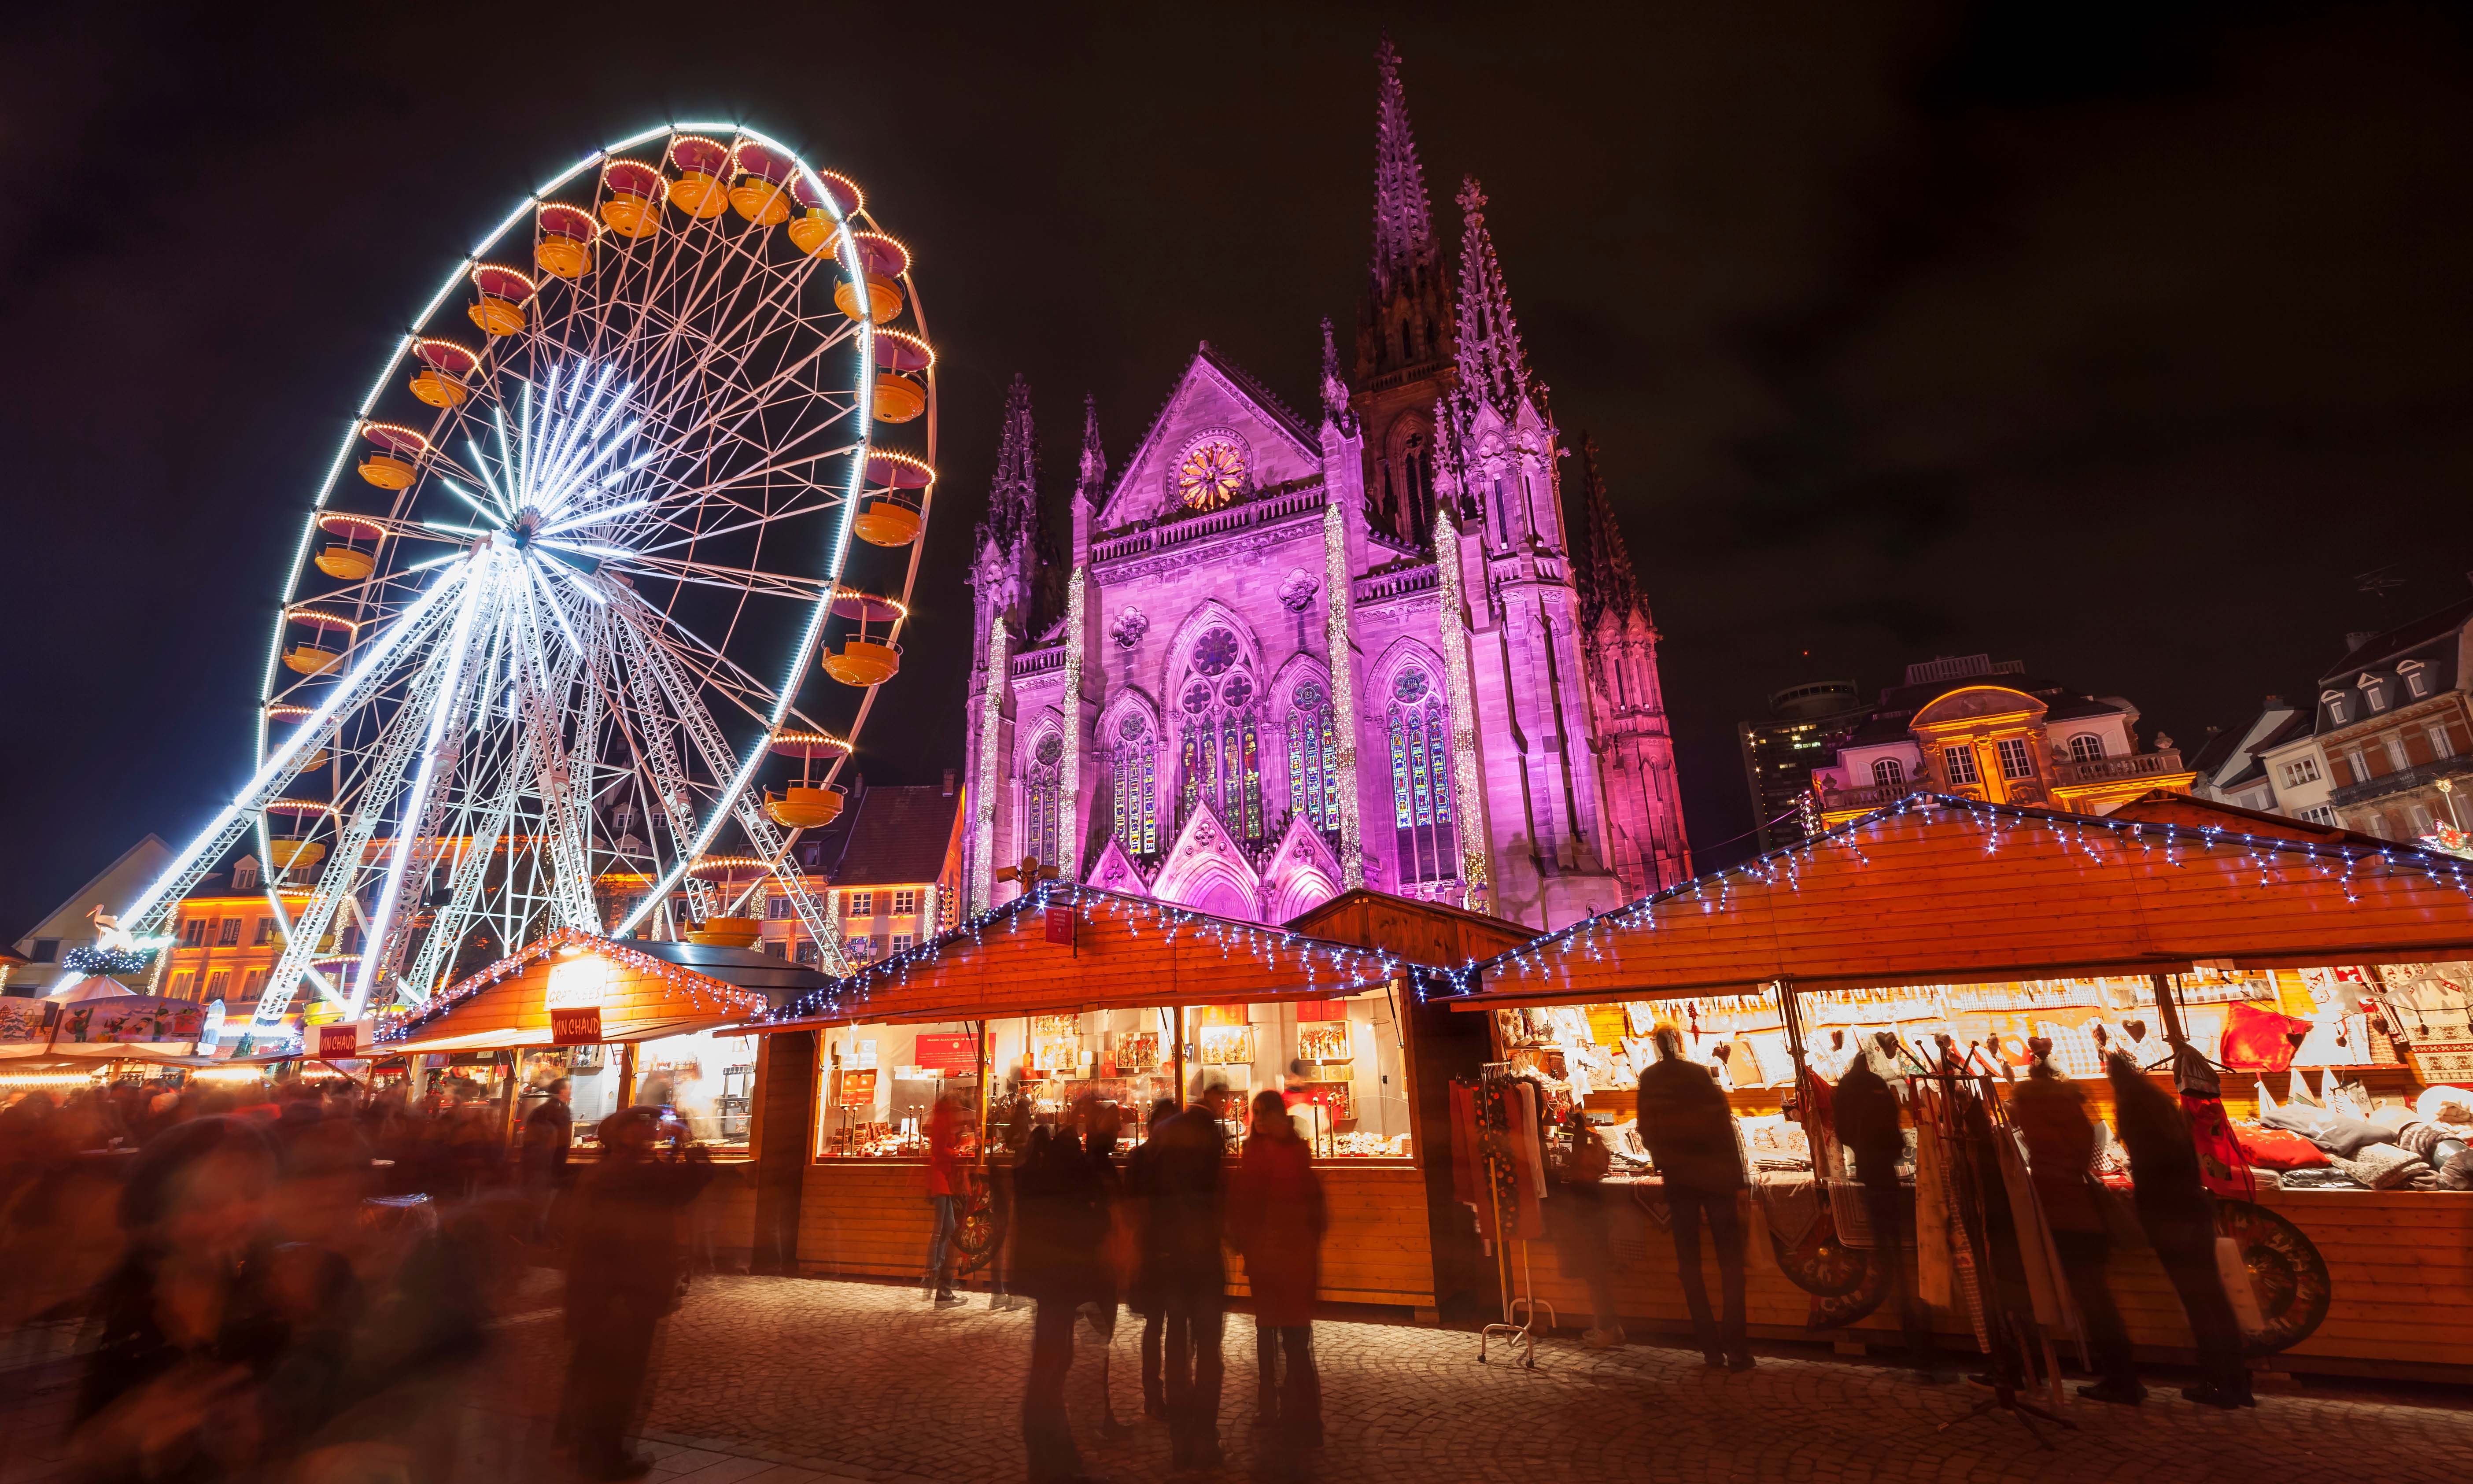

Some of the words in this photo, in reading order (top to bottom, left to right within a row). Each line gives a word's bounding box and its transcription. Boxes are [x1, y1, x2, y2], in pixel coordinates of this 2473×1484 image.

[554, 1019, 567, 1036] VIN
[568, 1017, 599, 1036] CHAUD
[321, 1036, 332, 1051] VIN
[332, 1035, 355, 1051] CHAUD
